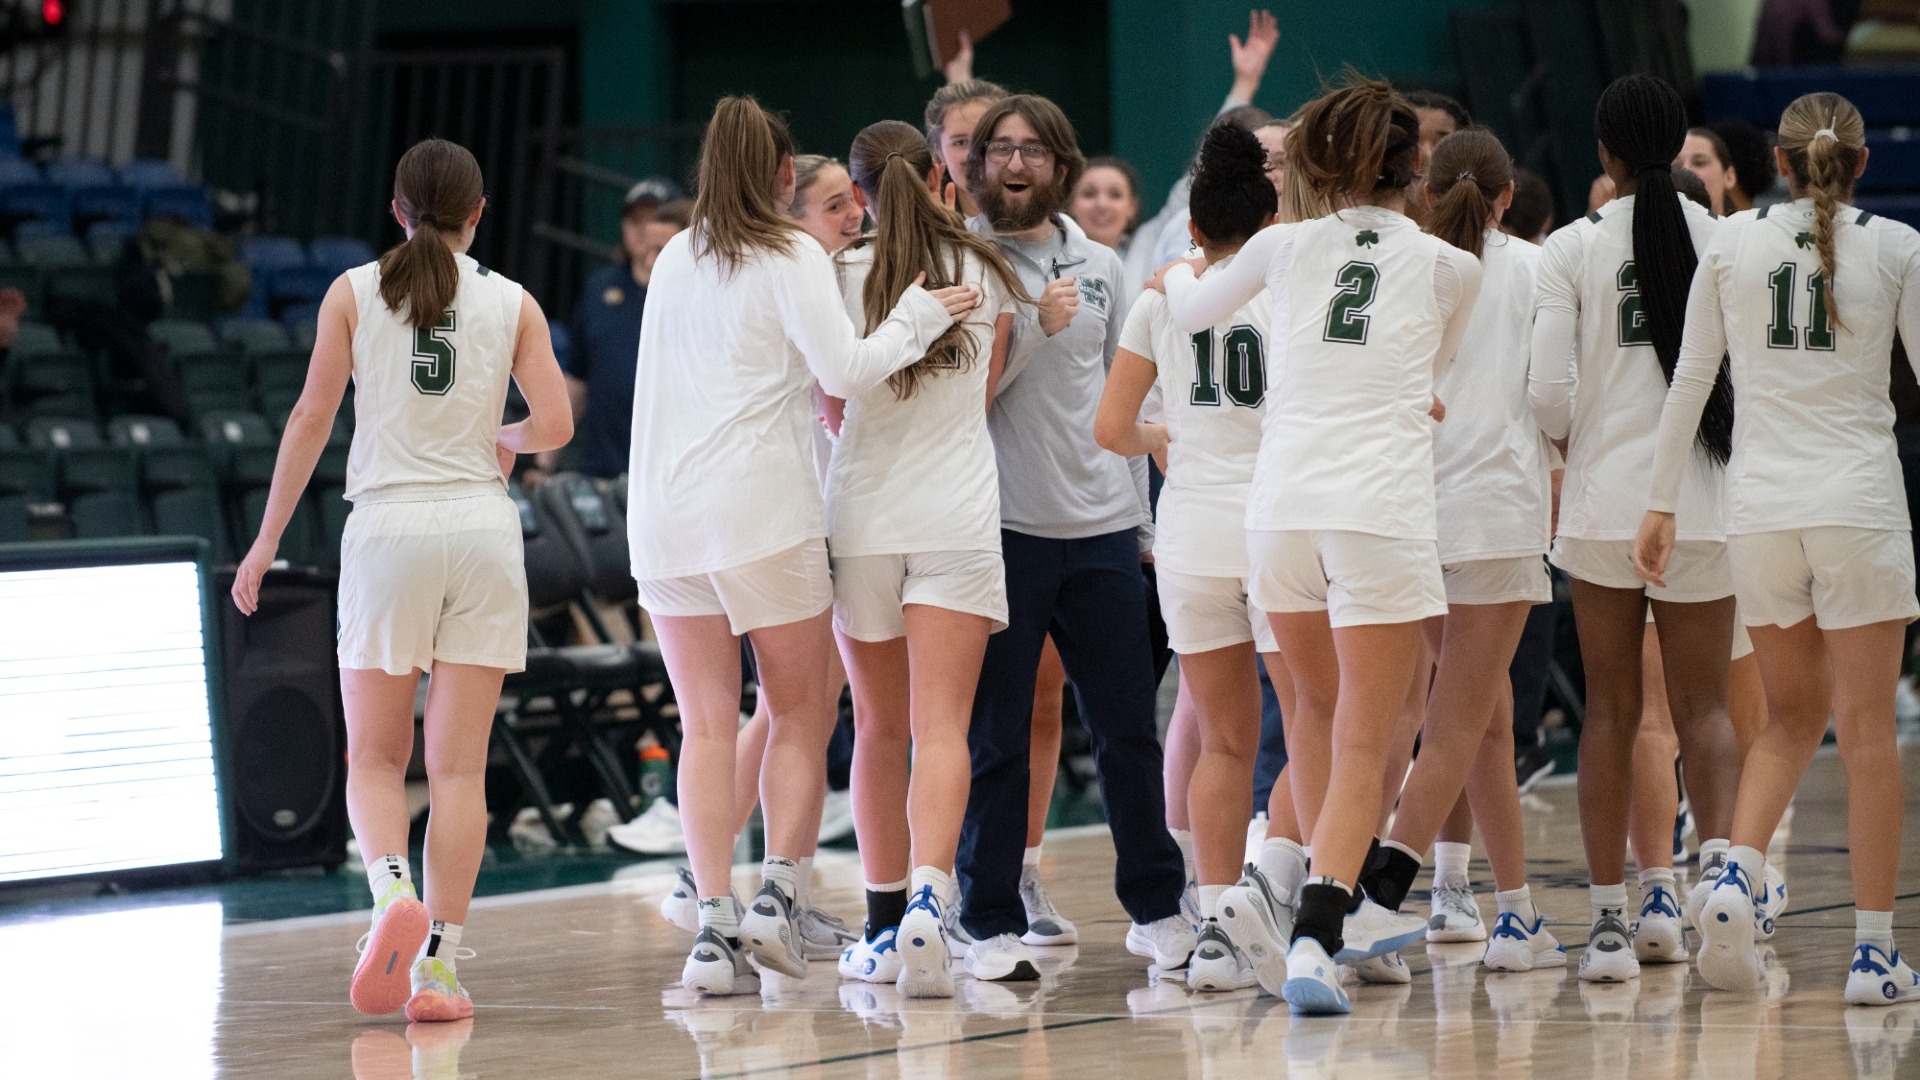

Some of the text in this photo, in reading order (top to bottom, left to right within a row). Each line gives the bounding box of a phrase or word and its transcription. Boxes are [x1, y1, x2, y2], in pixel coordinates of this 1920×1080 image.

[1323, 260, 1380, 345] 2
[1767, 261, 1836, 352] 11
[411, 310, 456, 396] 5
[1189, 324, 1267, 409] 10
